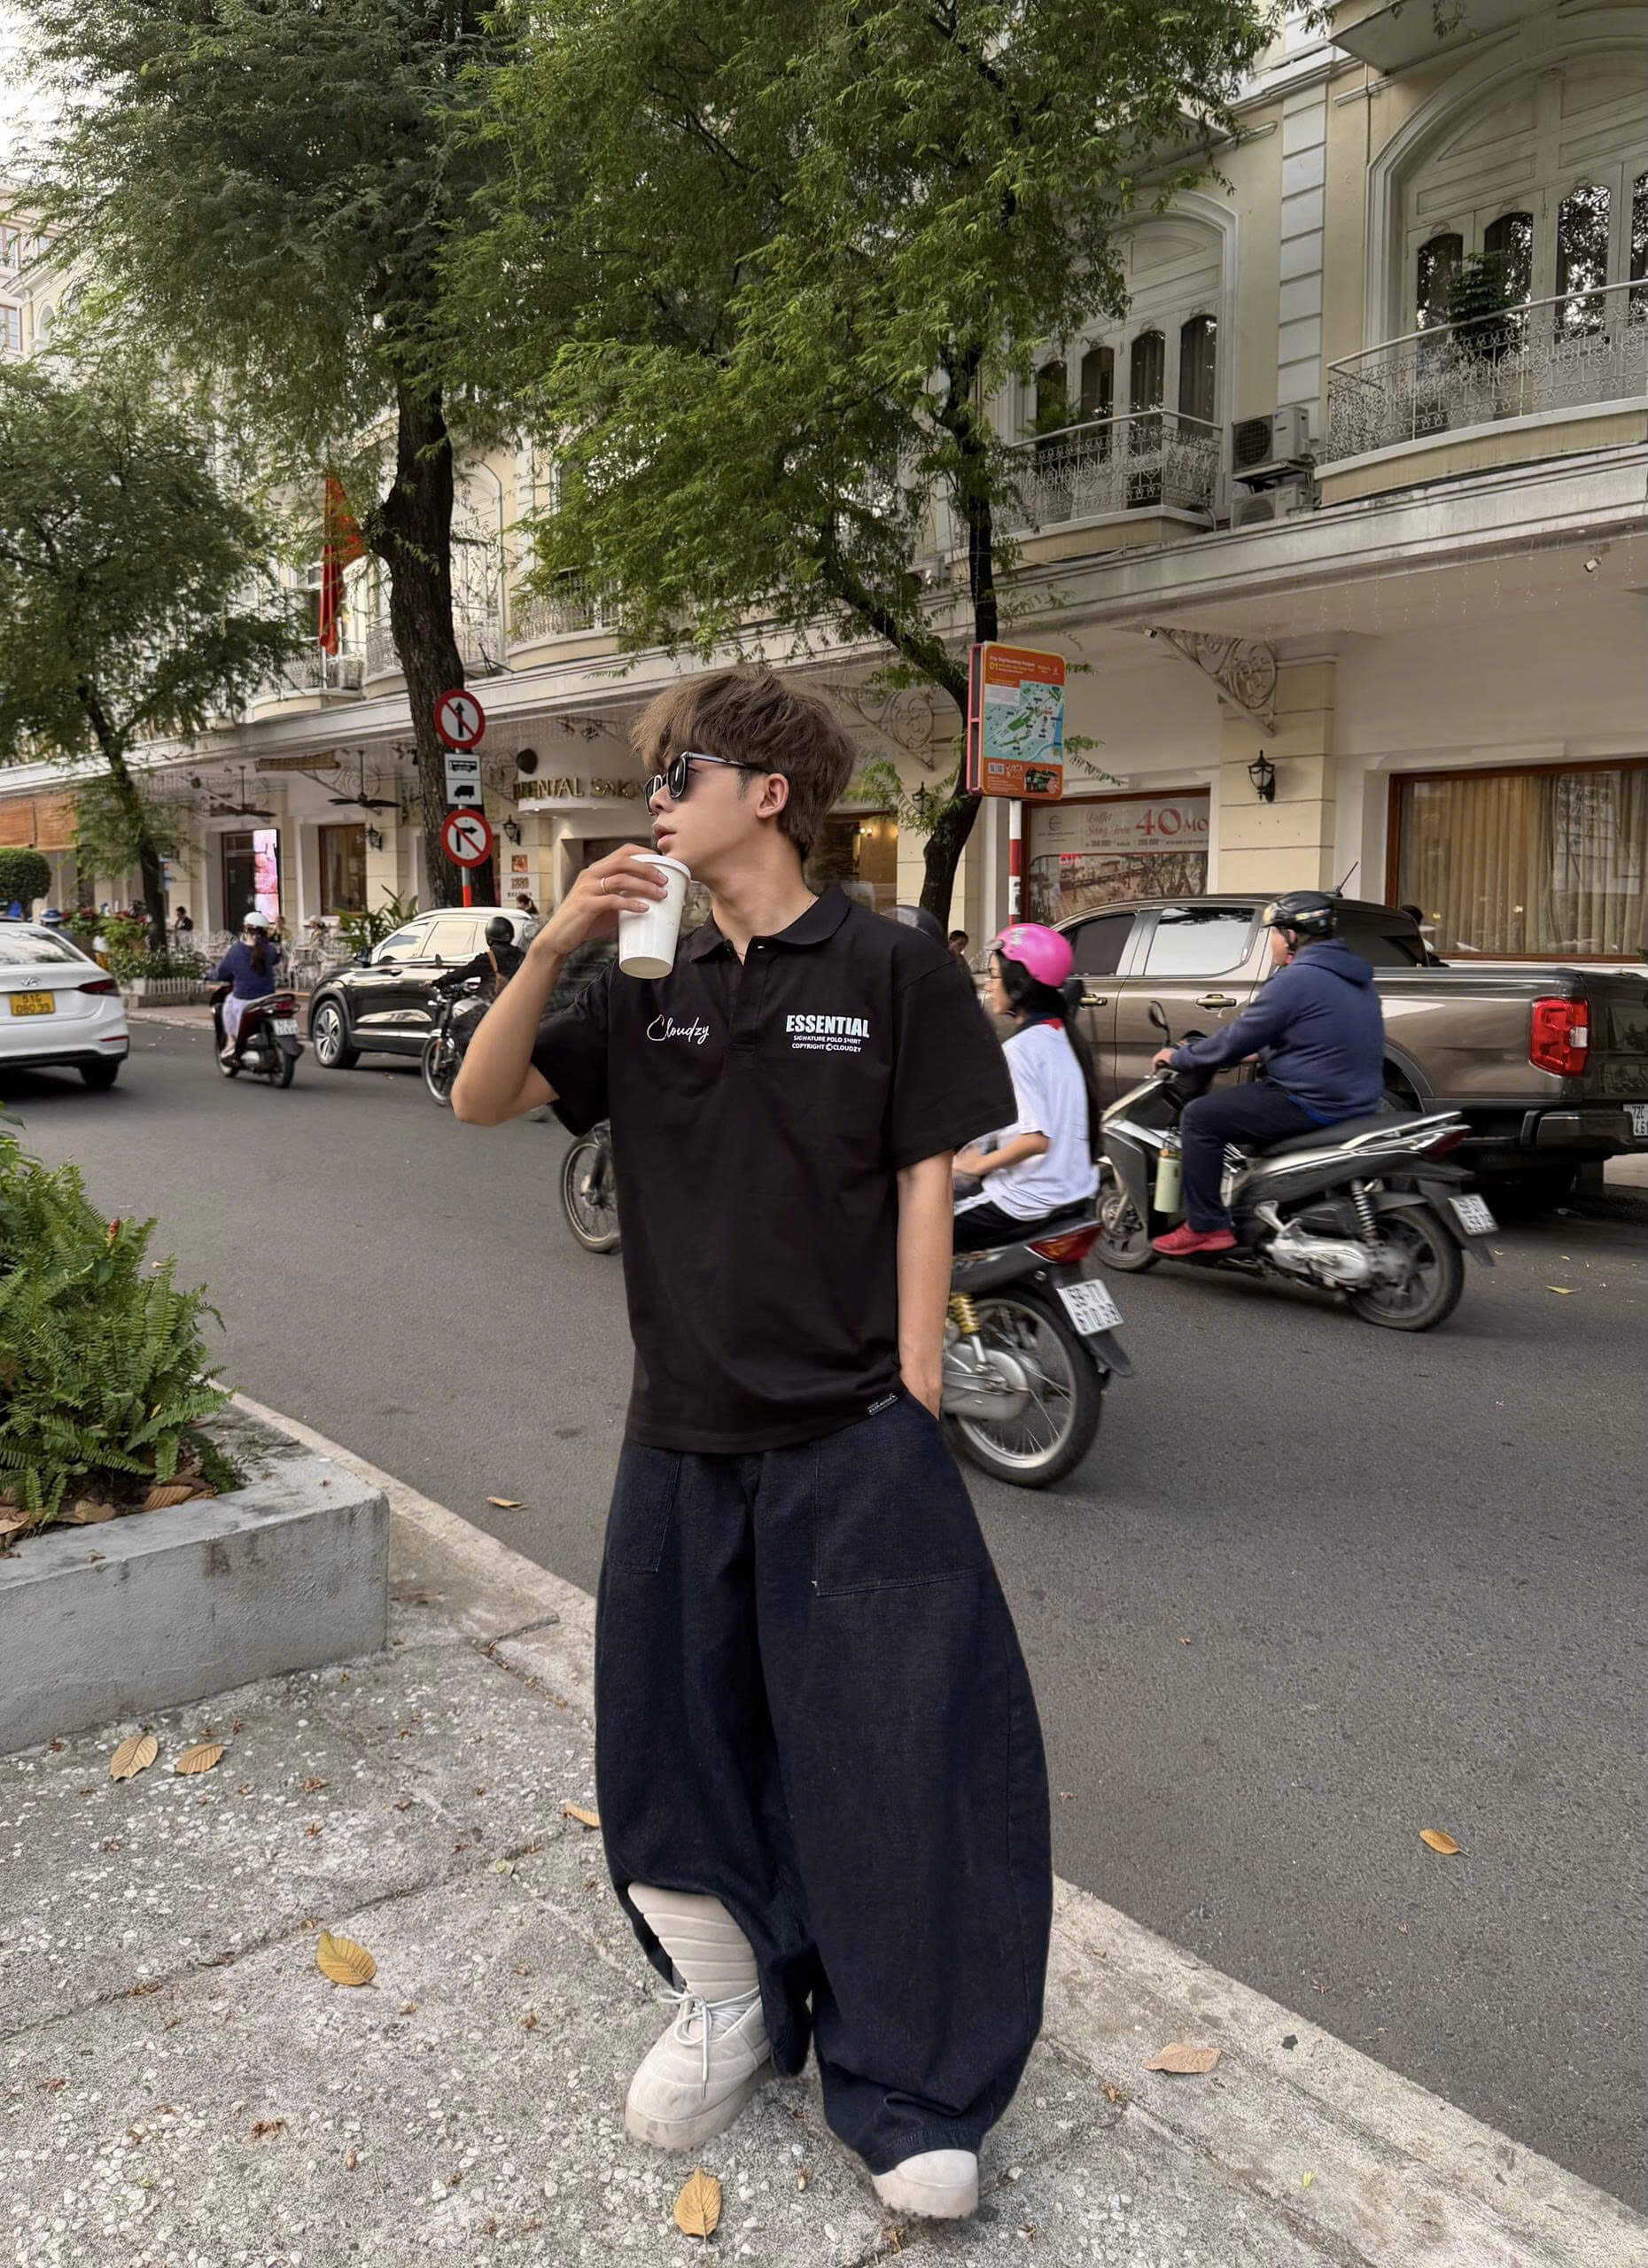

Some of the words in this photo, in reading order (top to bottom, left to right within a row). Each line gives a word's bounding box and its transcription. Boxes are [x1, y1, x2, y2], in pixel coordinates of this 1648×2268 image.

[1135, 807, 1182, 835] 40
[647, 1014, 710, 1045] Cloudzy
[785, 1014, 870, 1038] ESSENTIAL
[791, 1042, 825, 1051] COPYRIGHT
